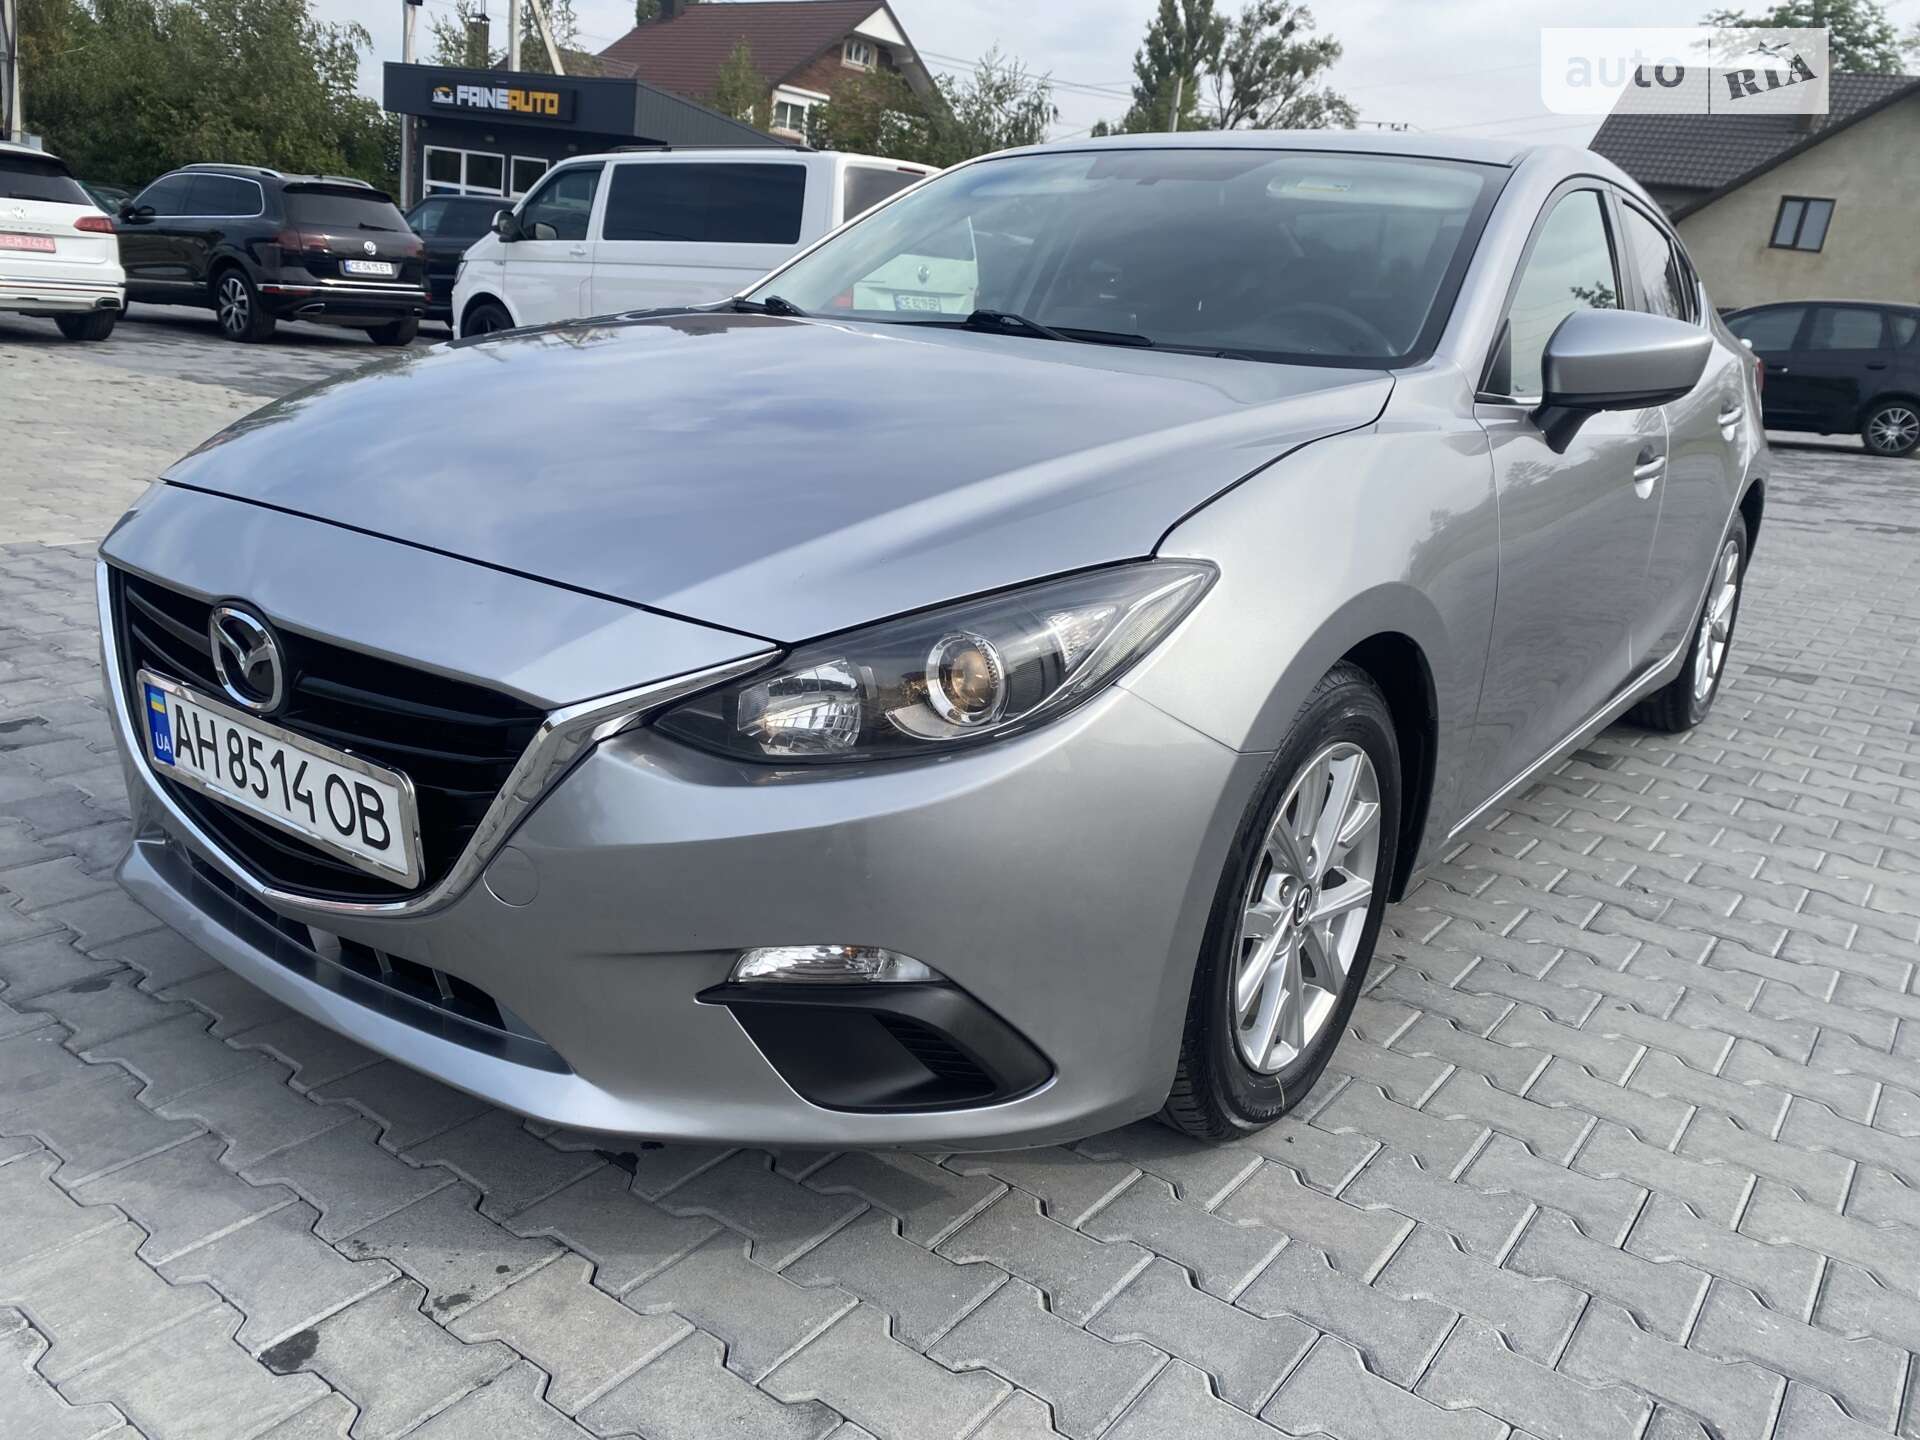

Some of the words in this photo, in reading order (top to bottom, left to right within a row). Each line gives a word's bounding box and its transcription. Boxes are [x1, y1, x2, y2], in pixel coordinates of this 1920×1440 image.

[154, 731, 172, 754] UA
[175, 703, 221, 779] AH
[226, 728, 316, 824] 8514
[325, 773, 391, 851] OB
